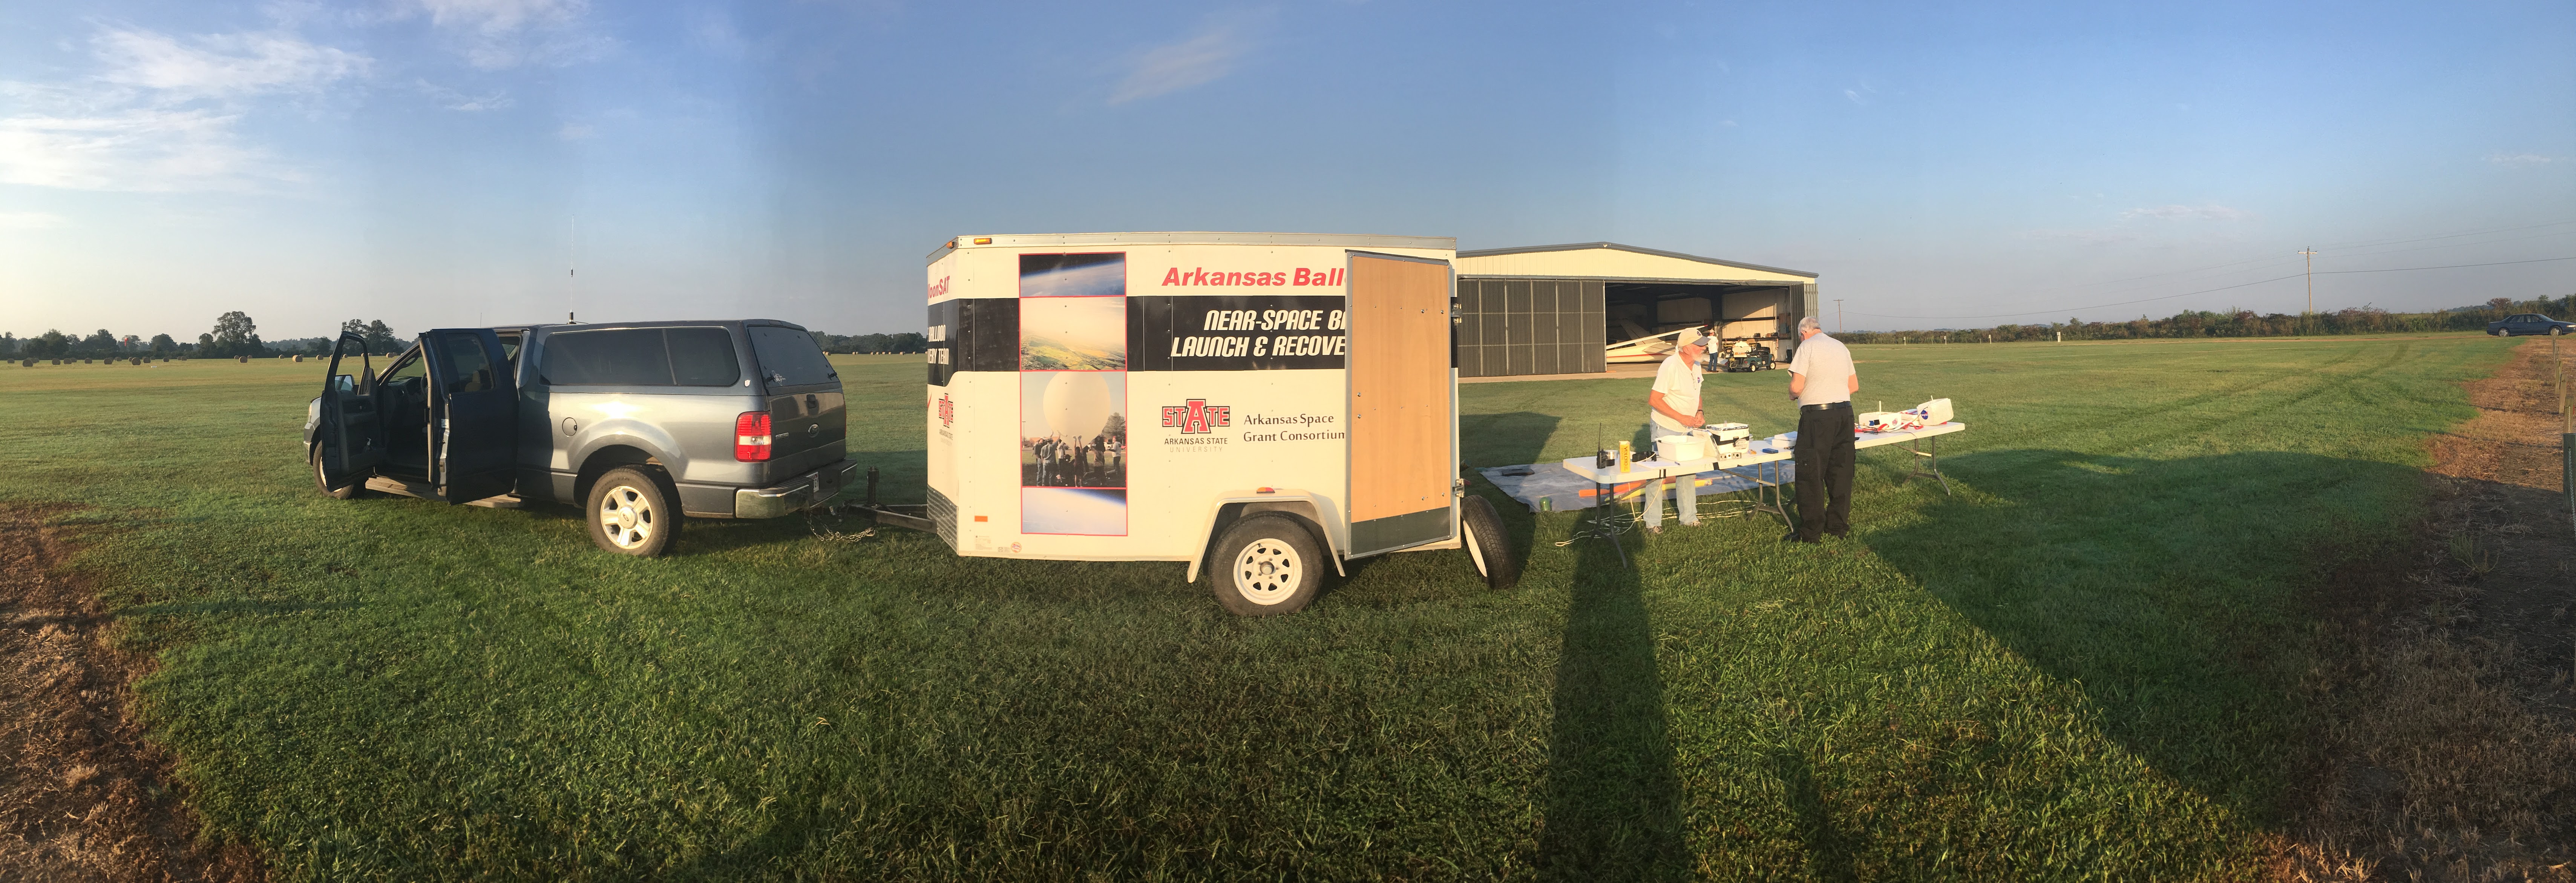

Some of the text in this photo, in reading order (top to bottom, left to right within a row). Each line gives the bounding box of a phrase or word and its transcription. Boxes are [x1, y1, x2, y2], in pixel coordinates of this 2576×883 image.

[1162, 267, 1345, 286] Arkansas Ball
[1204, 310, 1324, 330] NEAR-SPACE
[929, 325, 946, 342] BALLOON
[1171, 336, 1345, 357] LAUNCH & RECOVE
[938, 348, 949, 365] TEAM
[939, 393, 953, 428] STATE
[1162, 399, 1230, 434] STATE
[1244, 413, 1334, 427] Arkansas Space
[1244, 432, 1277, 442] Grant
